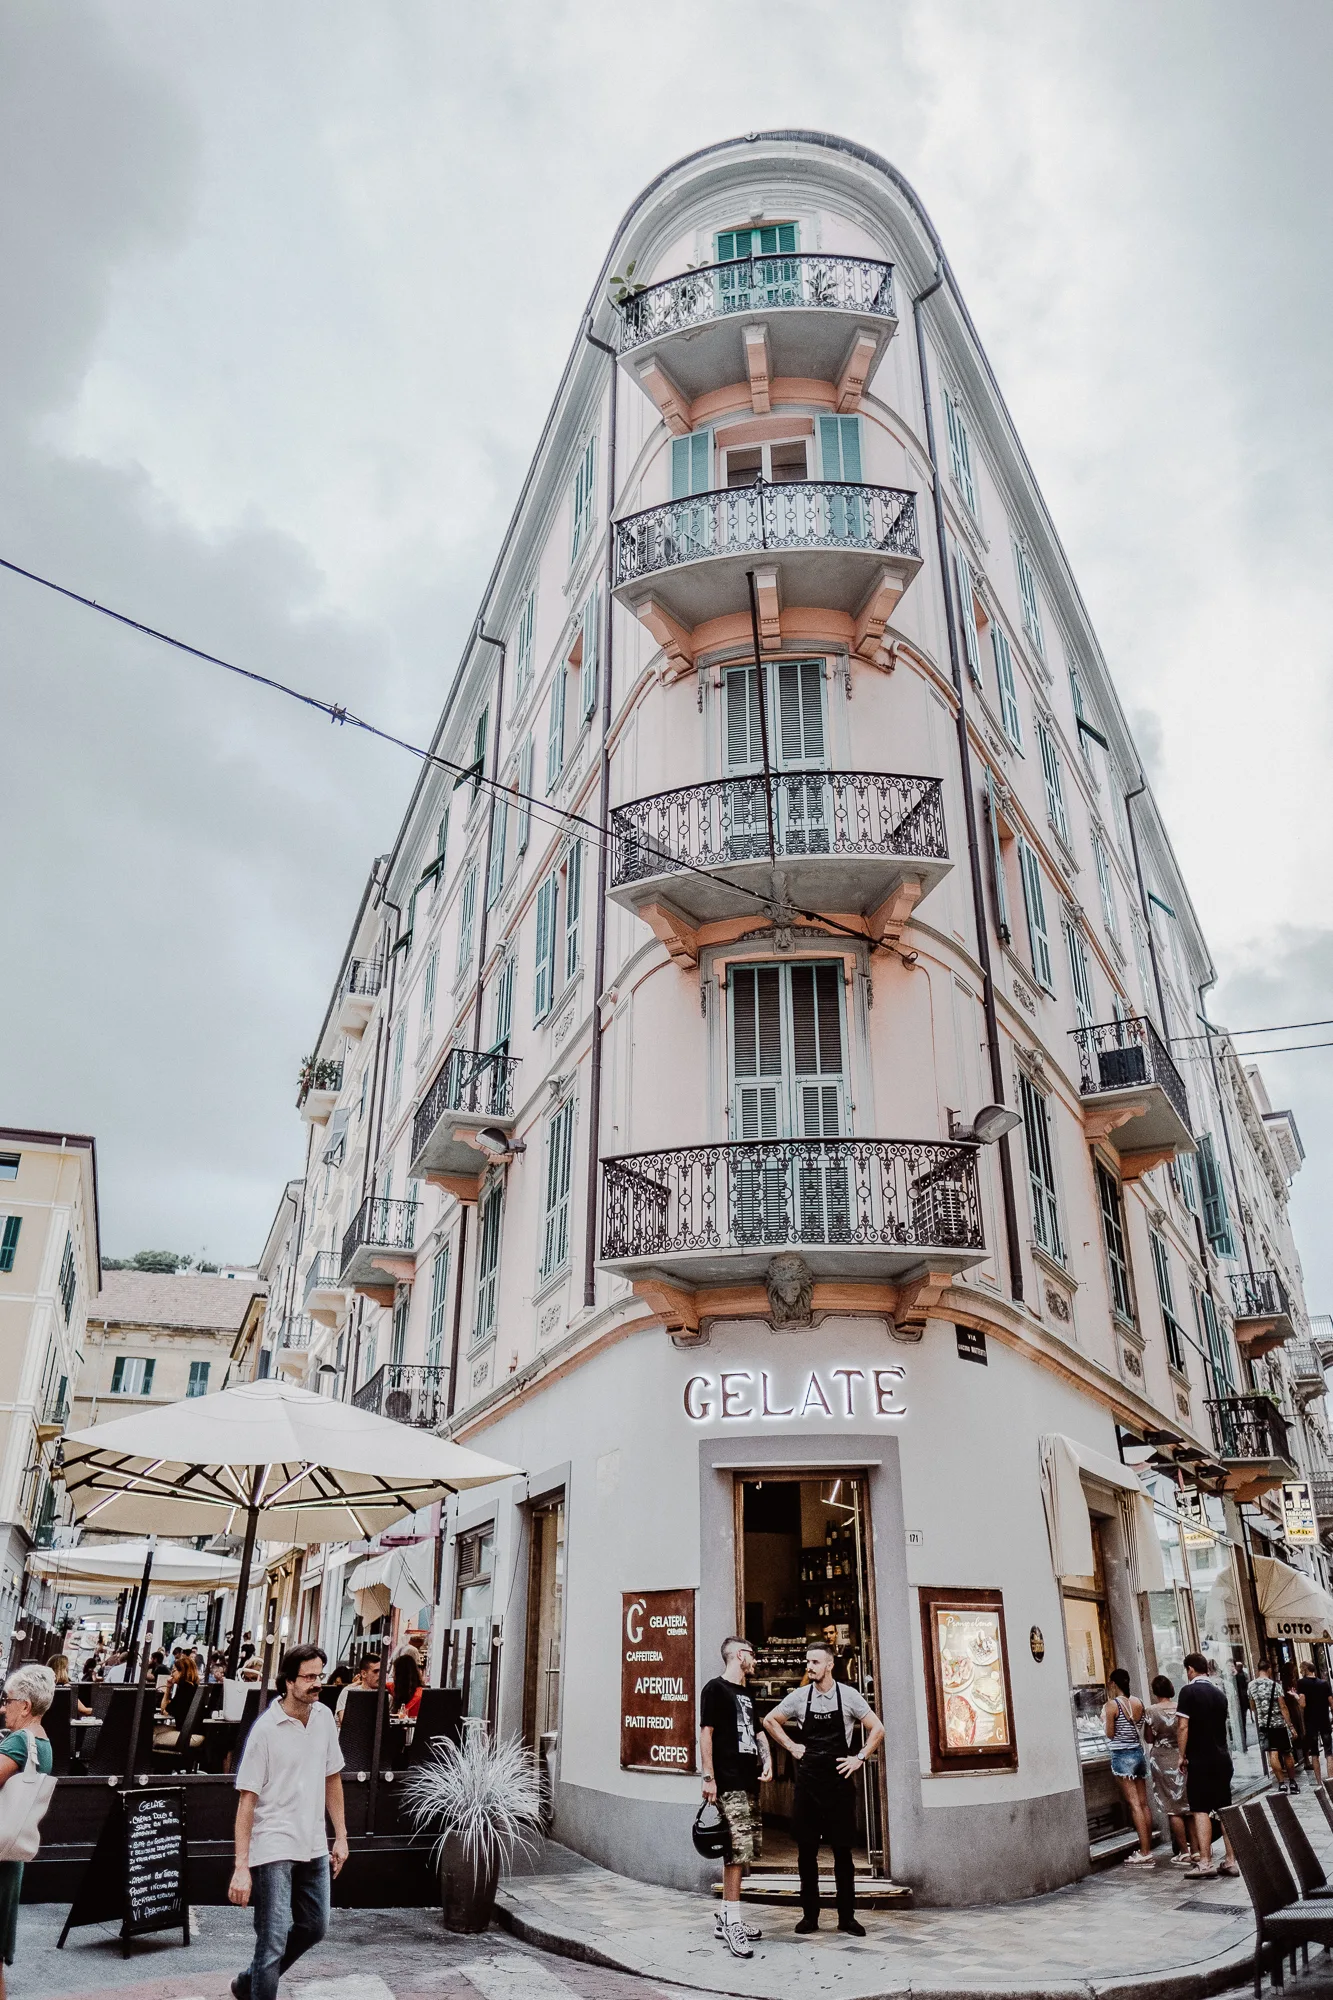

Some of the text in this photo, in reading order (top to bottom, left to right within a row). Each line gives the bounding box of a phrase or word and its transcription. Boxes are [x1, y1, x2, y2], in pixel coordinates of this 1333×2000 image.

[967, 1333, 977, 1342] VIA
[909, 1533, 919, 1543] 171
[649, 1615, 688, 1628] GELATERIA
[1277, 1622, 1313, 1635] LOTTO
[626, 1650, 664, 1662] CAFFETTERIA
[634, 1676, 684, 1694] APERITIVI
[625, 1715, 673, 1729] PIATTI FREDDI
[650, 1744, 688, 1763] CREPES
